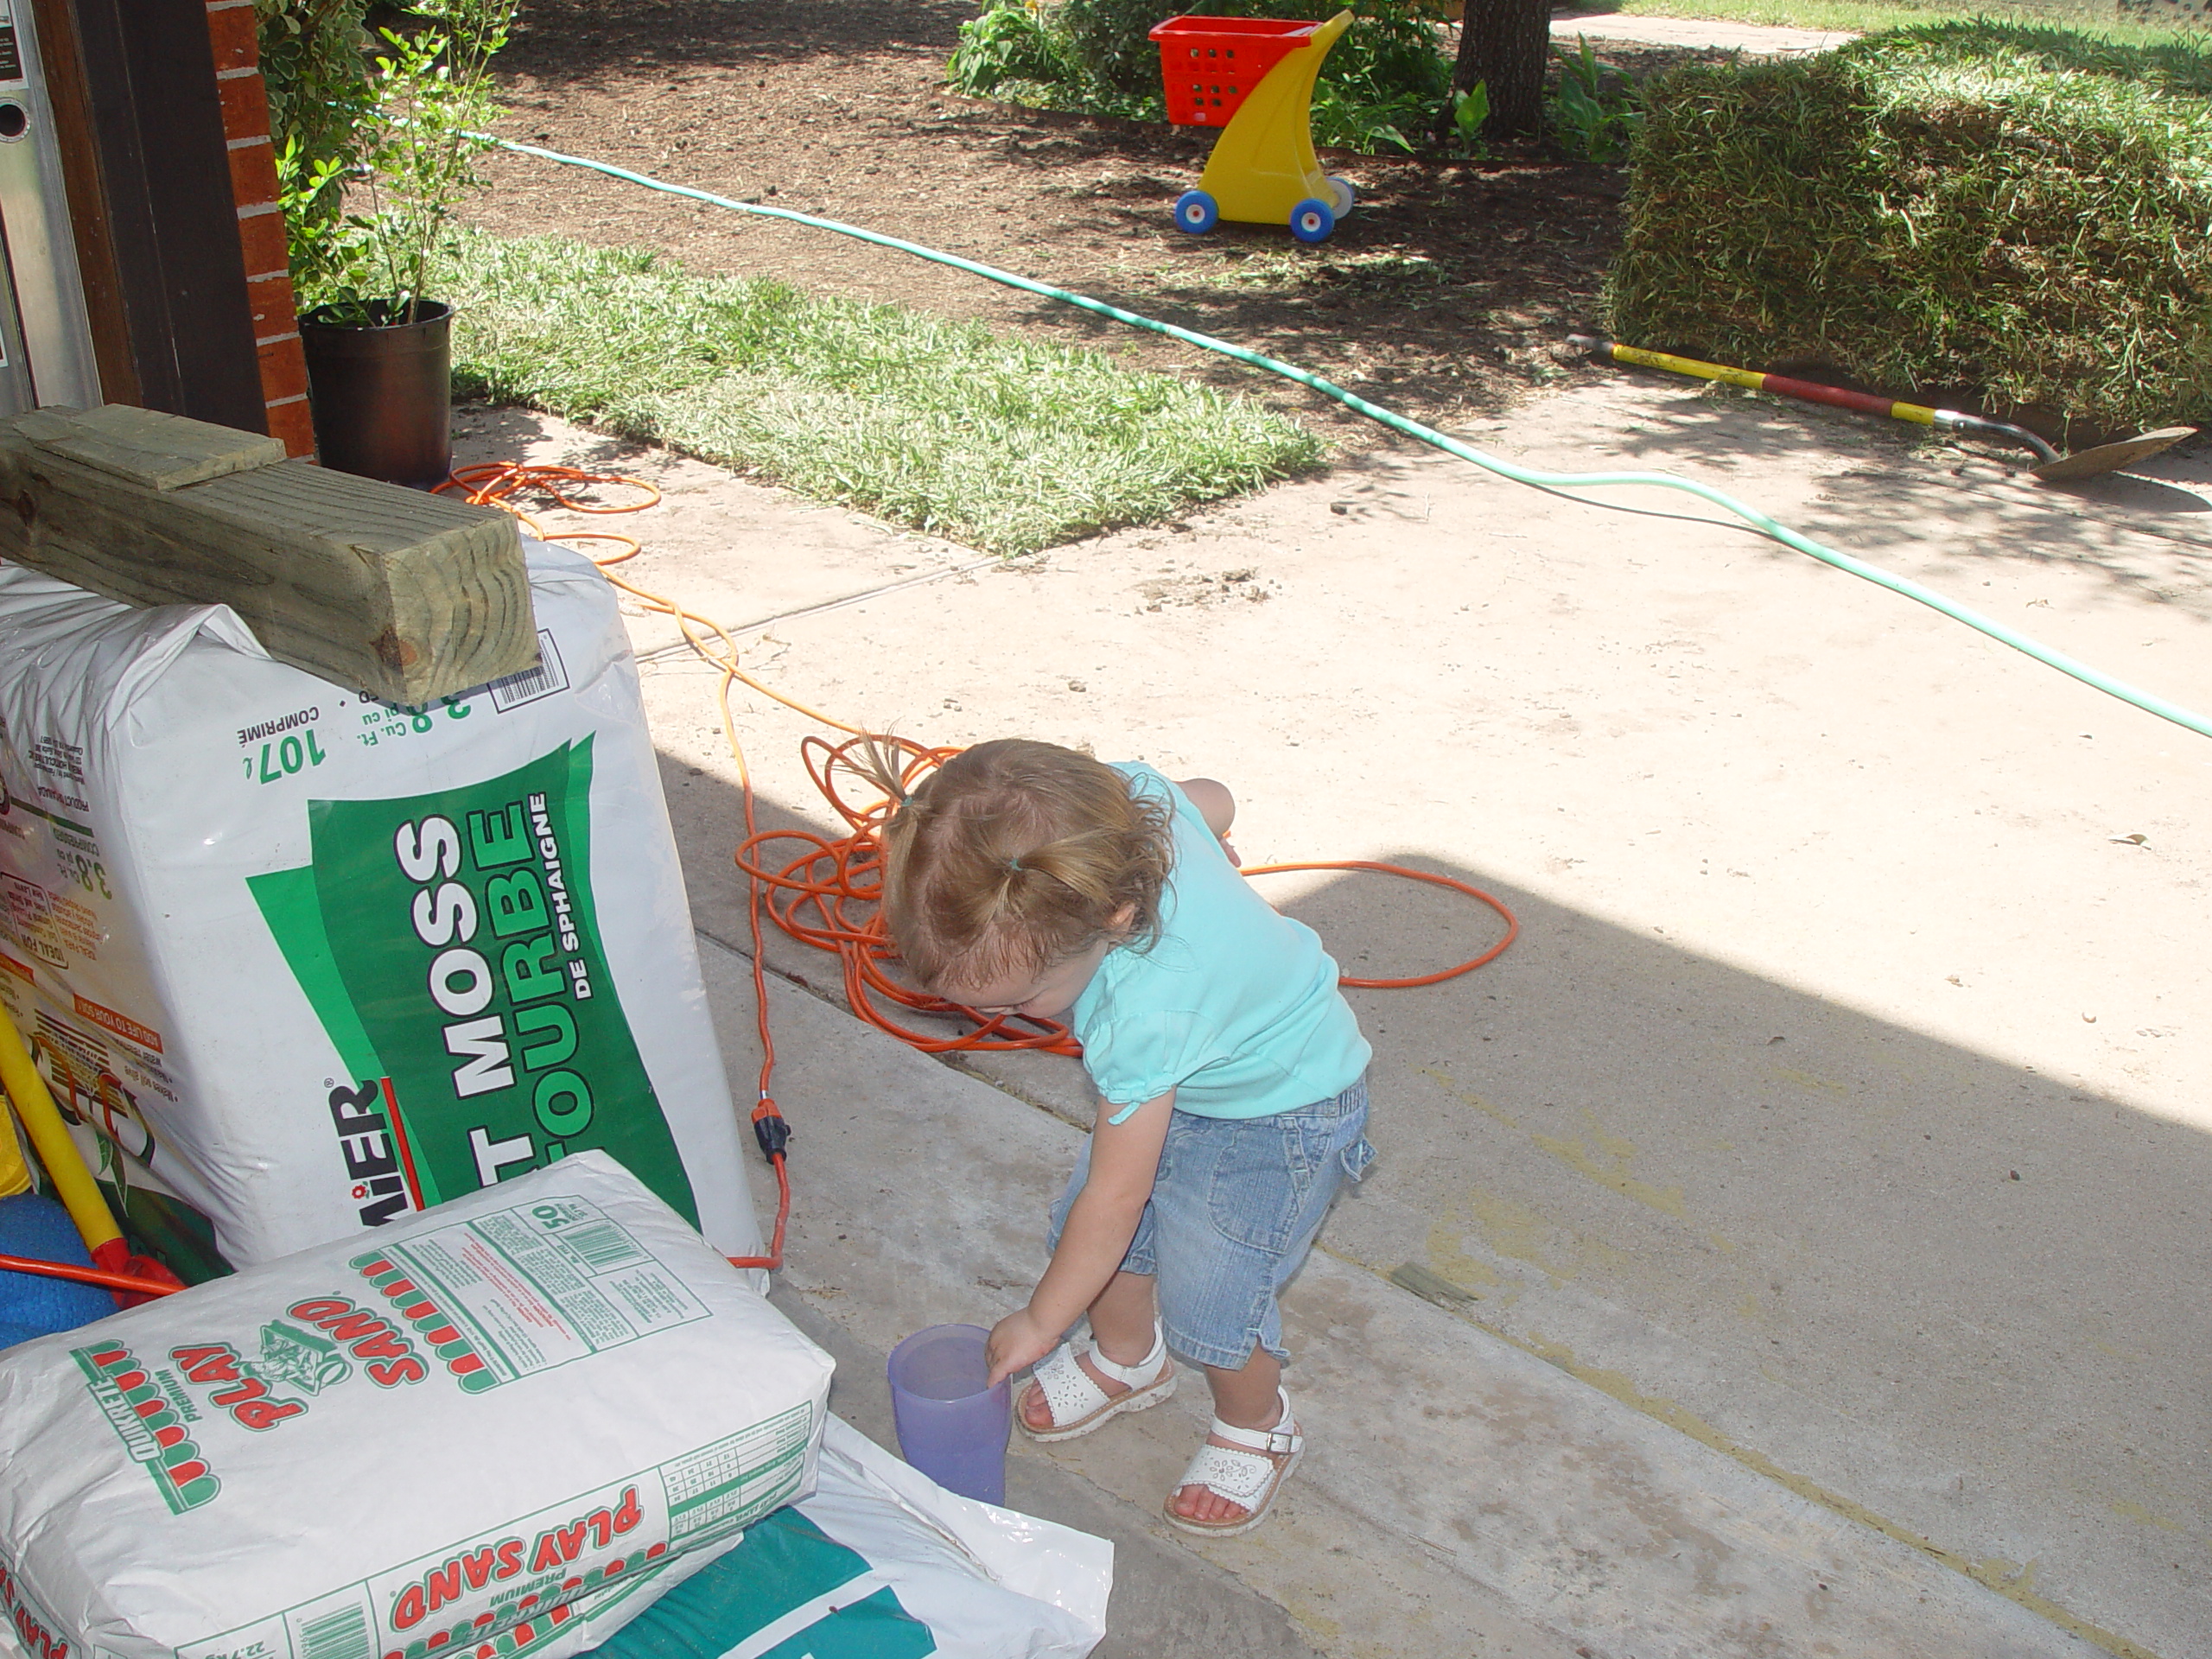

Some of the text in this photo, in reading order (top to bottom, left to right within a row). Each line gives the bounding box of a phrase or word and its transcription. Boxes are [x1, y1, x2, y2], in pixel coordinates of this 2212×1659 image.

[237, 706, 320, 749] COMPRIMÉ
[356, 721, 407, 747] Cu. Ft.
[362, 709, 381, 726] cu
[260, 728, 326, 785] 107
[75, 854, 112, 900] 3.8
[527, 791, 593, 1001] DE SPHAIGNE
[38, 940, 65, 963] IDEAL
[393, 813, 517, 1102] MOSS
[96, 1007, 116, 1027] YOUR
[116, 1016, 127, 1030] TO
[128, 1022, 143, 1039] LIFE
[531, 1205, 570, 1230] 50
[287, 1296, 429, 1389] SAND
[154, 1369, 203, 1423] PREMIUM
[170, 1342, 308, 1432] PLAY
[89, 1376, 162, 1461] QUIKRETE
[526, 1484, 645, 1575] PLAY
[390, 1536, 525, 1632] SAND
[490, 1567, 567, 1607] PREMIUM
